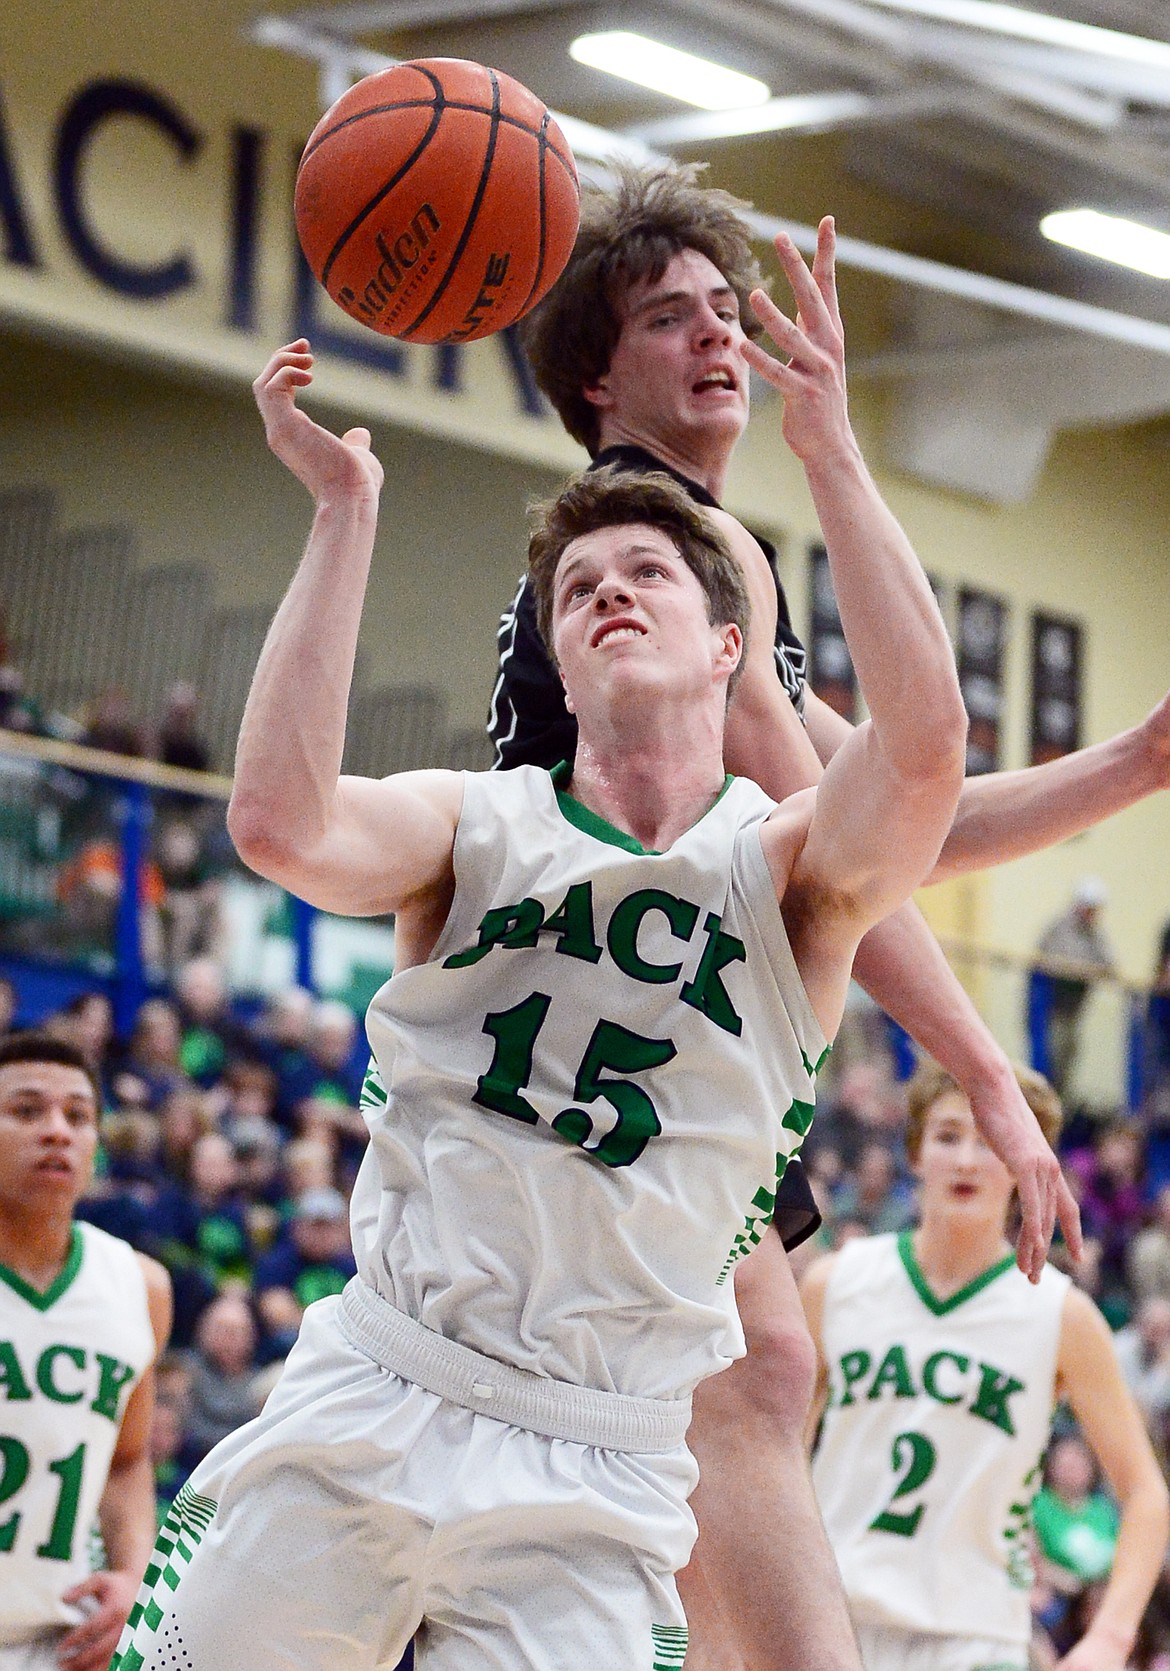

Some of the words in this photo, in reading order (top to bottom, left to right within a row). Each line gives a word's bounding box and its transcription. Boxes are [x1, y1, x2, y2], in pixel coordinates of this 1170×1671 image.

[442, 880, 746, 1038] PACK
[471, 991, 678, 1168] 15
[838, 1345, 1025, 1437] PACK
[868, 1431, 936, 1538] 2
